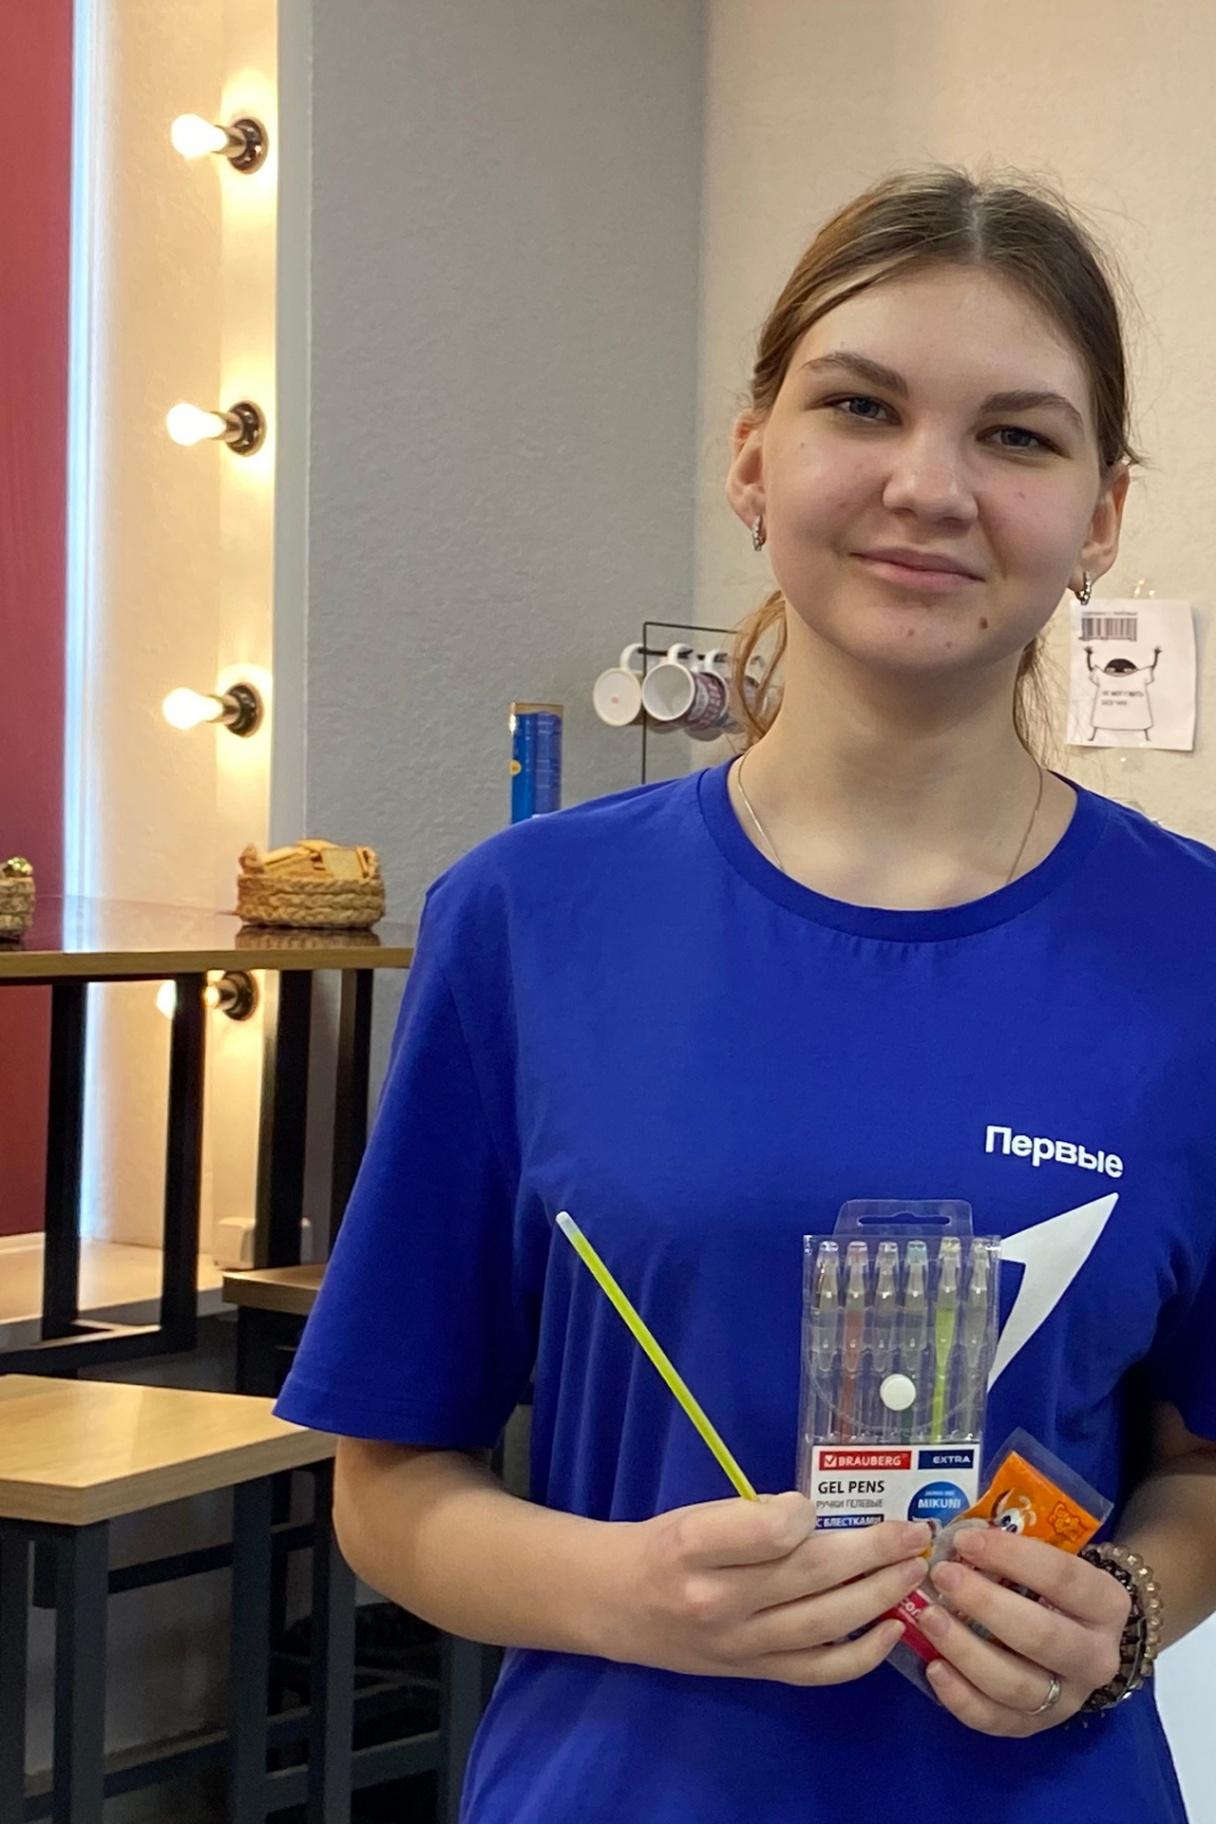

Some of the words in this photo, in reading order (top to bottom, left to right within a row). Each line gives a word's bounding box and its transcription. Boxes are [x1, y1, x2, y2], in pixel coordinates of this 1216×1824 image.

[985, 1125, 1124, 1178] Первые
[838, 1455, 902, 1466] BRAUBERG
[932, 1455, 971, 1464] EXTRA
[818, 1481, 845, 1494] GEL
[848, 1480, 885, 1493] PENS
[816, 1500, 845, 1509] РУЧКИ
[846, 1499, 883, 1508] ГЕЛЕВЫЕ
[918, 1498, 961, 1509] MIKUNI
